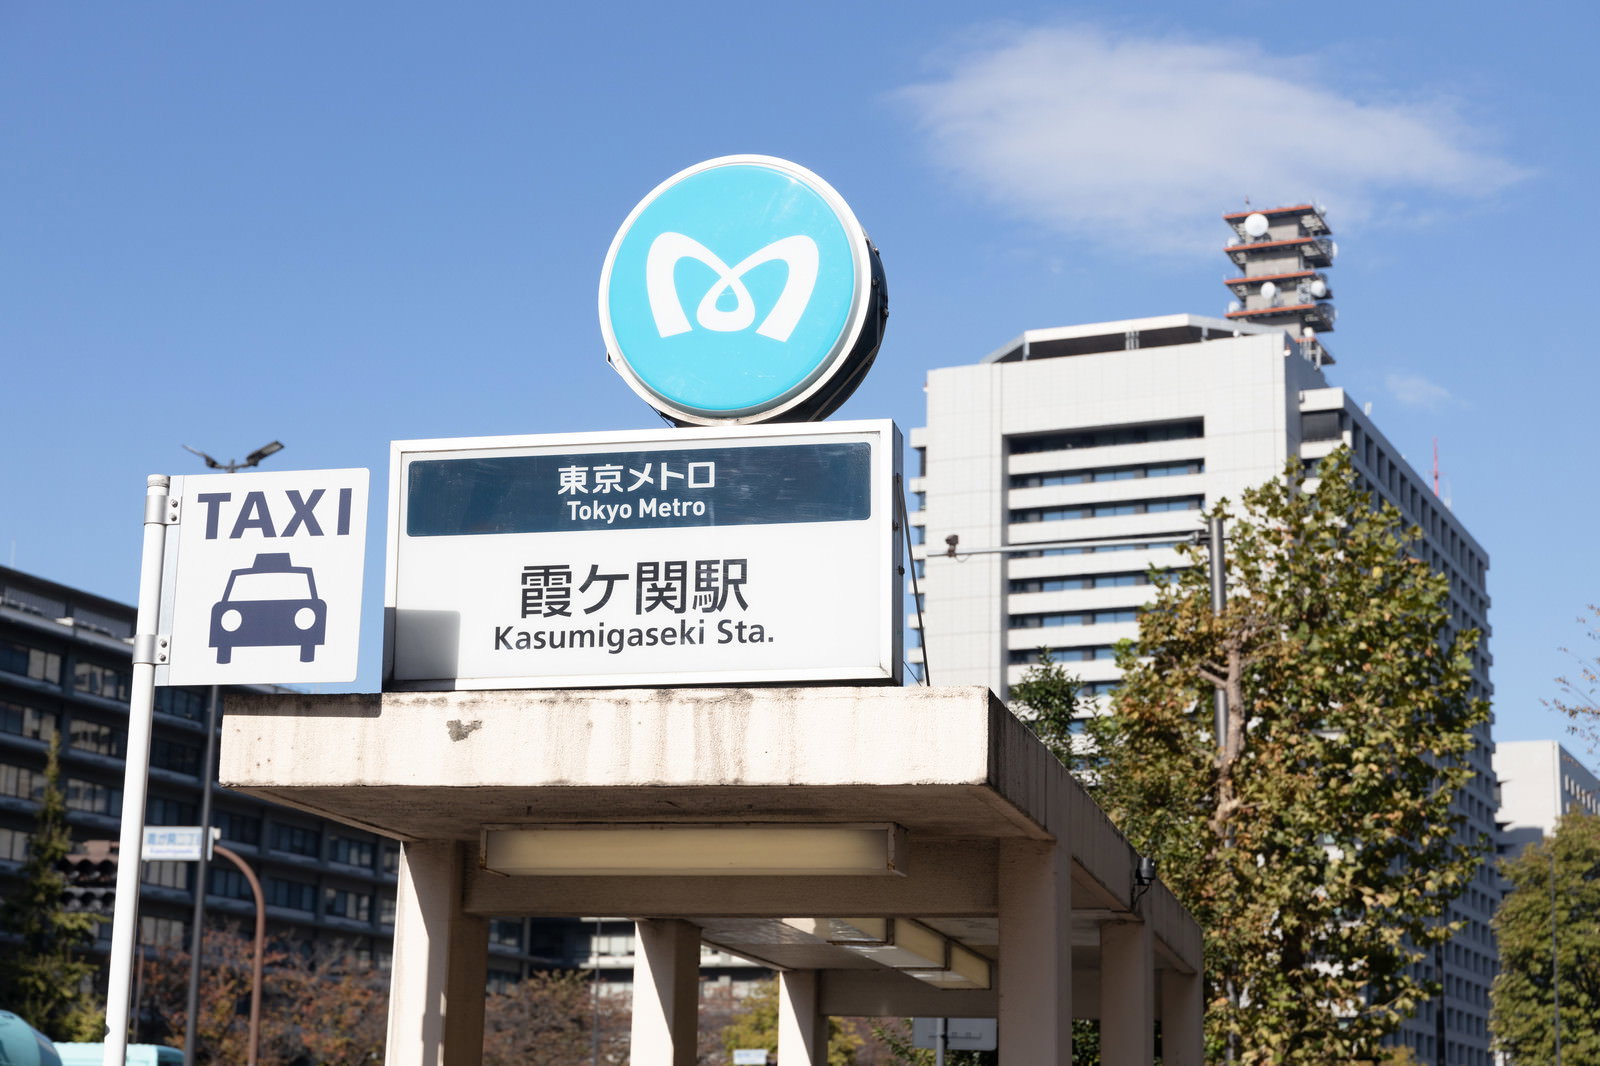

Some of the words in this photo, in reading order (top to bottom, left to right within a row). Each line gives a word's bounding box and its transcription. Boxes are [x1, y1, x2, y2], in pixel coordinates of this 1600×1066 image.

[557, 461, 716, 496] 東京メトロ
[197, 487, 353, 540] TAXI
[566, 501, 632, 525] Tokyo
[639, 497, 706, 518] Metro
[520, 558, 749, 619] 霞ケ関駅
[494, 619, 705, 655] Kasumigaseki
[717, 619, 774, 645] Sta.
